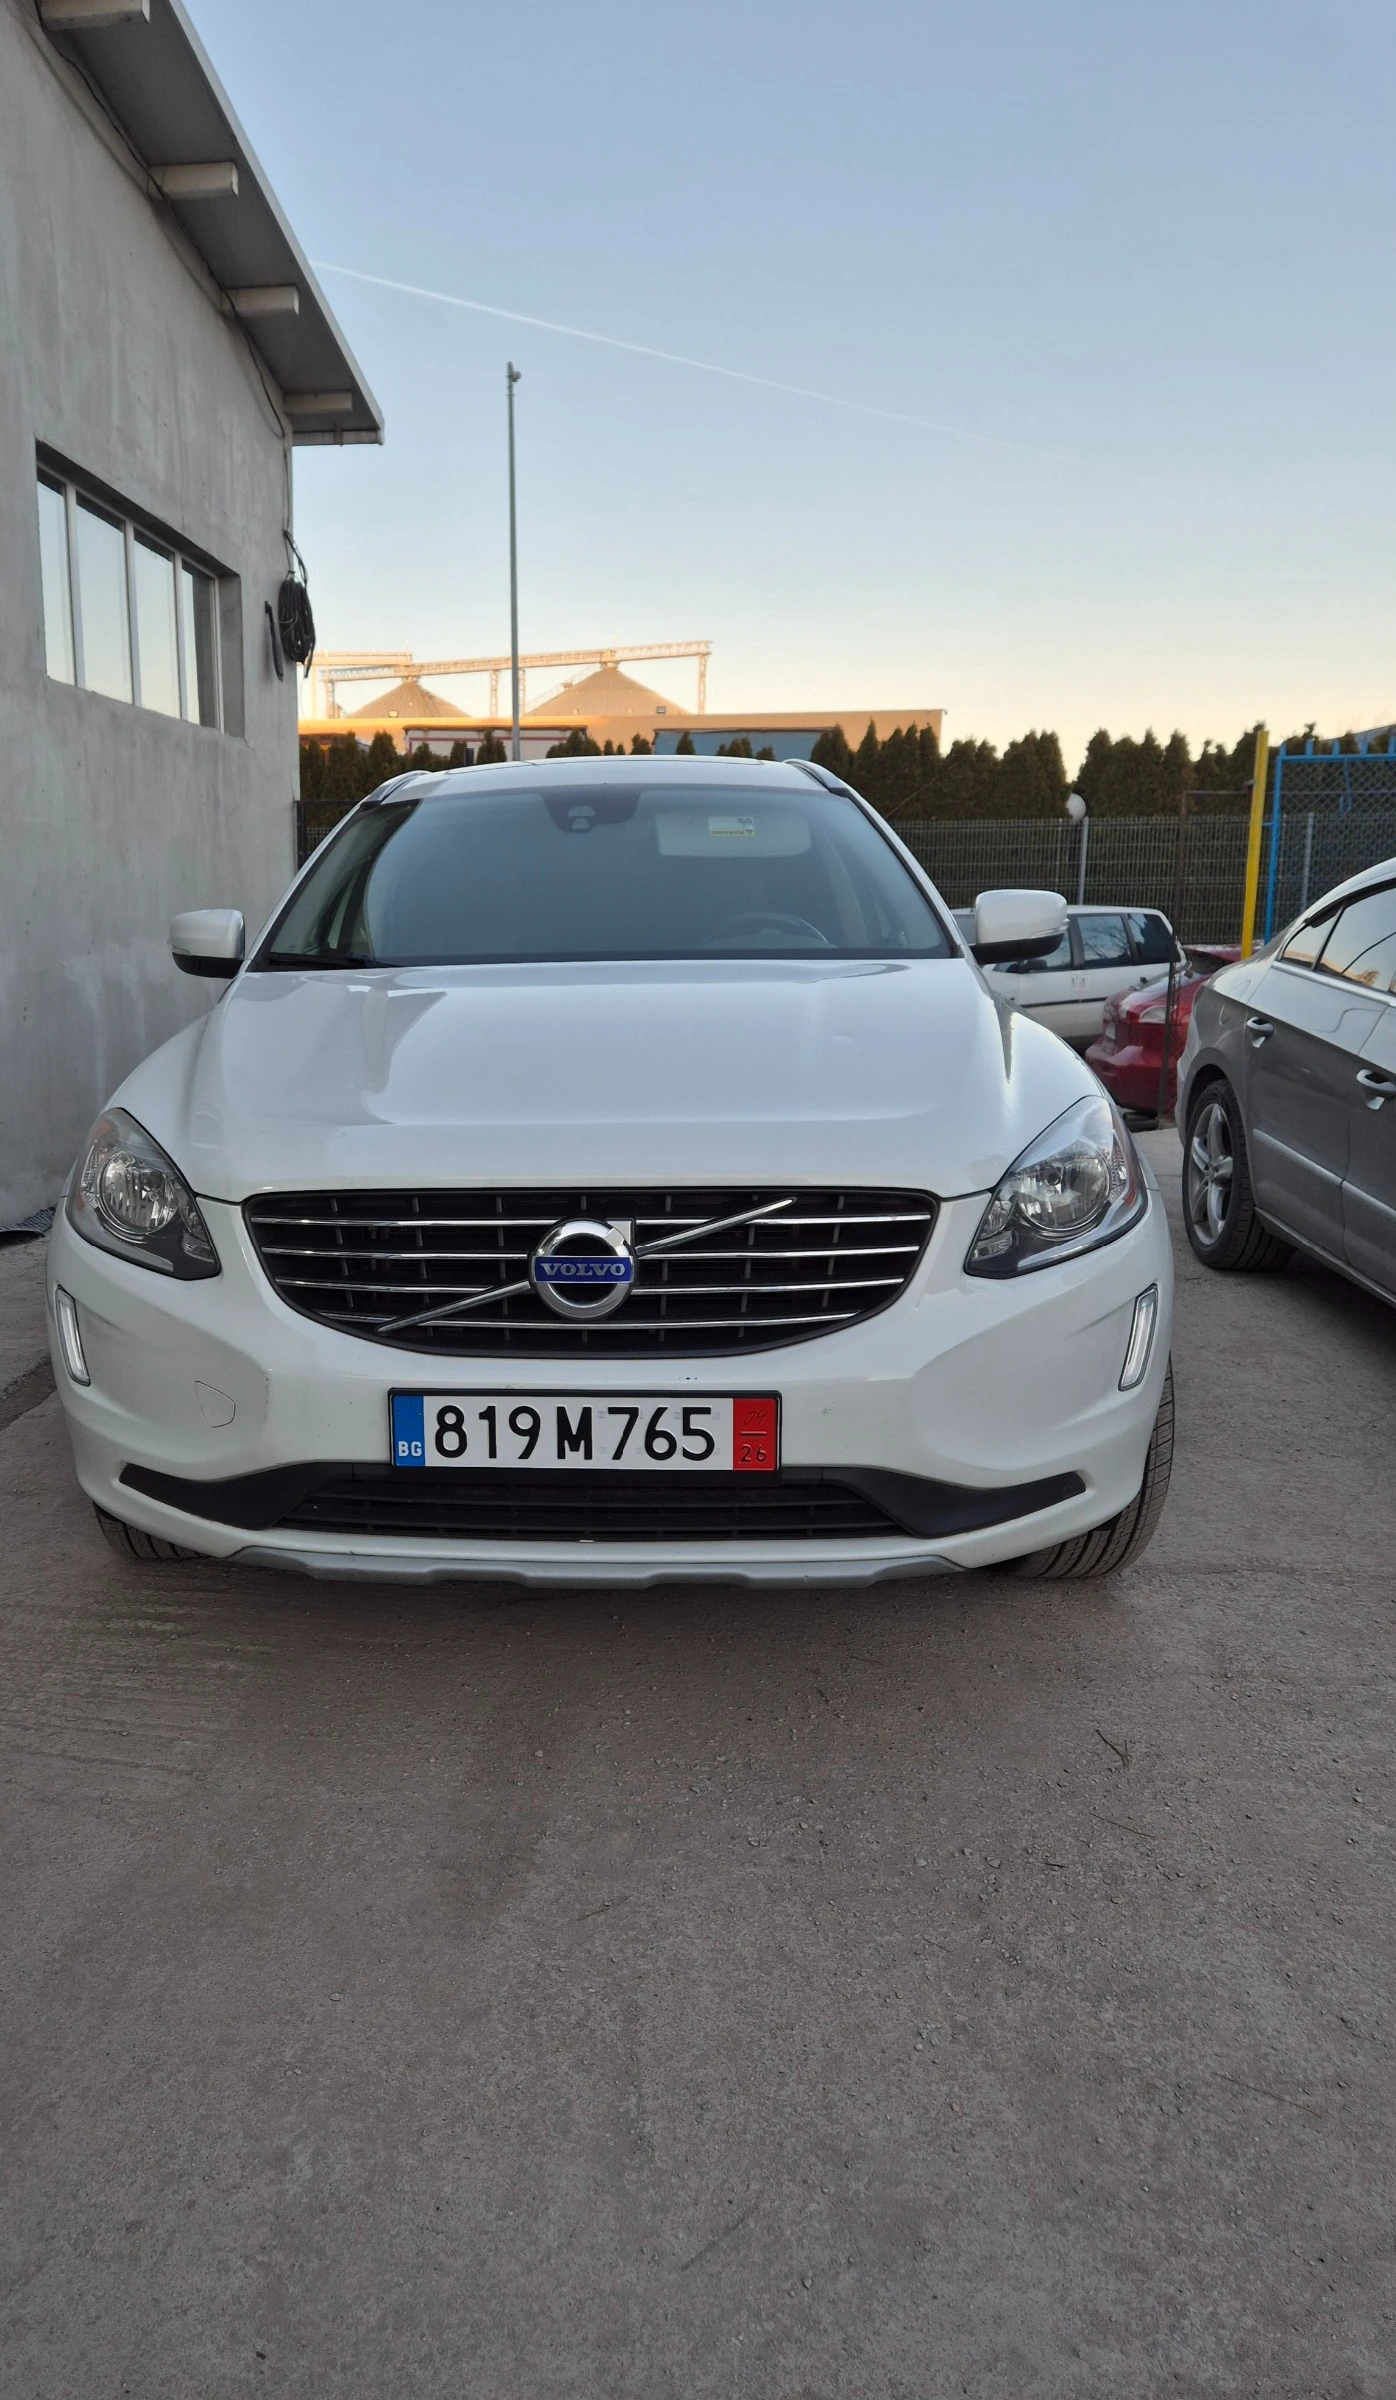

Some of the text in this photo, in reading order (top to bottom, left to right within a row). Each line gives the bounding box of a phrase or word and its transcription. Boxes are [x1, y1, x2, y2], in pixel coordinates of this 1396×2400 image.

[540, 1263, 626, 1277] VOLVO
[397, 1440, 423, 1458] BG
[740, 1443, 767, 1463] 26
